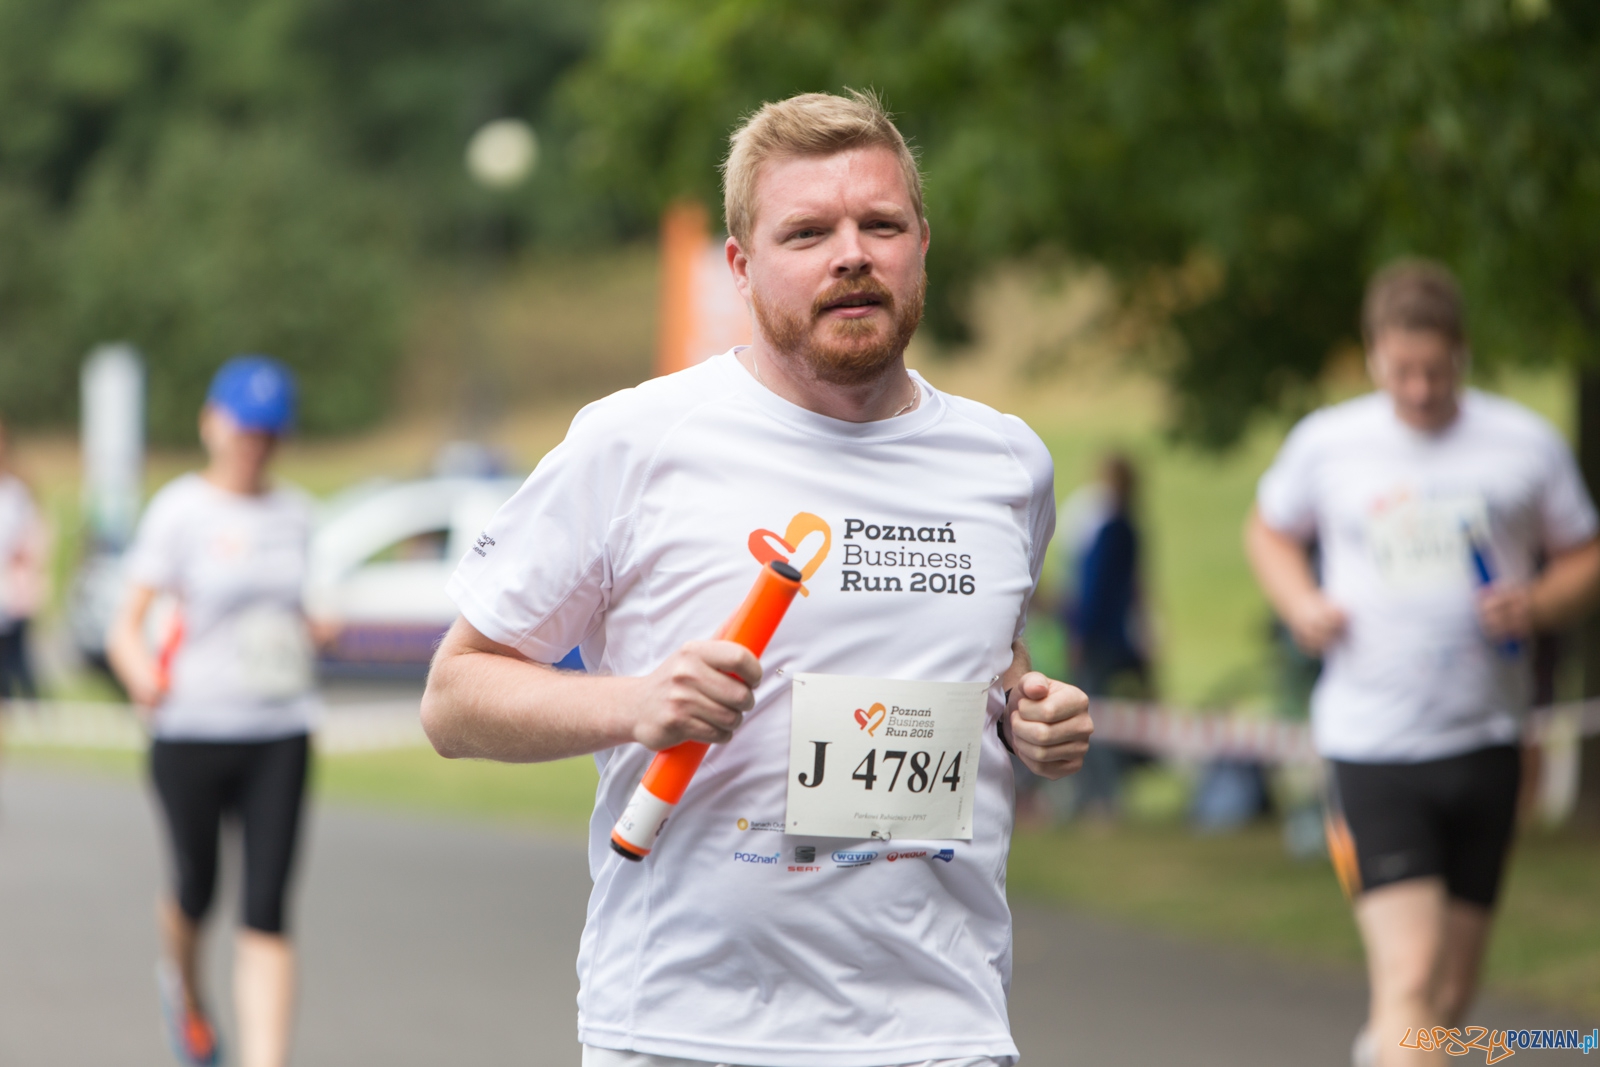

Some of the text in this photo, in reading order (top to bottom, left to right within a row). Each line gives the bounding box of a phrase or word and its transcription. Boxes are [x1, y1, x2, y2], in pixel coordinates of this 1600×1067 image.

[843, 518, 956, 543] Poznań
[842, 544, 972, 569] Business
[840, 570, 976, 595] Run 2016
[890, 705, 932, 717] Poznań
[887, 716, 935, 728] Business
[885, 727, 934, 739] Run 2016
[798, 740, 833, 789] J
[851, 748, 963, 794] 478/4
[837, 853, 873, 861] wavin
